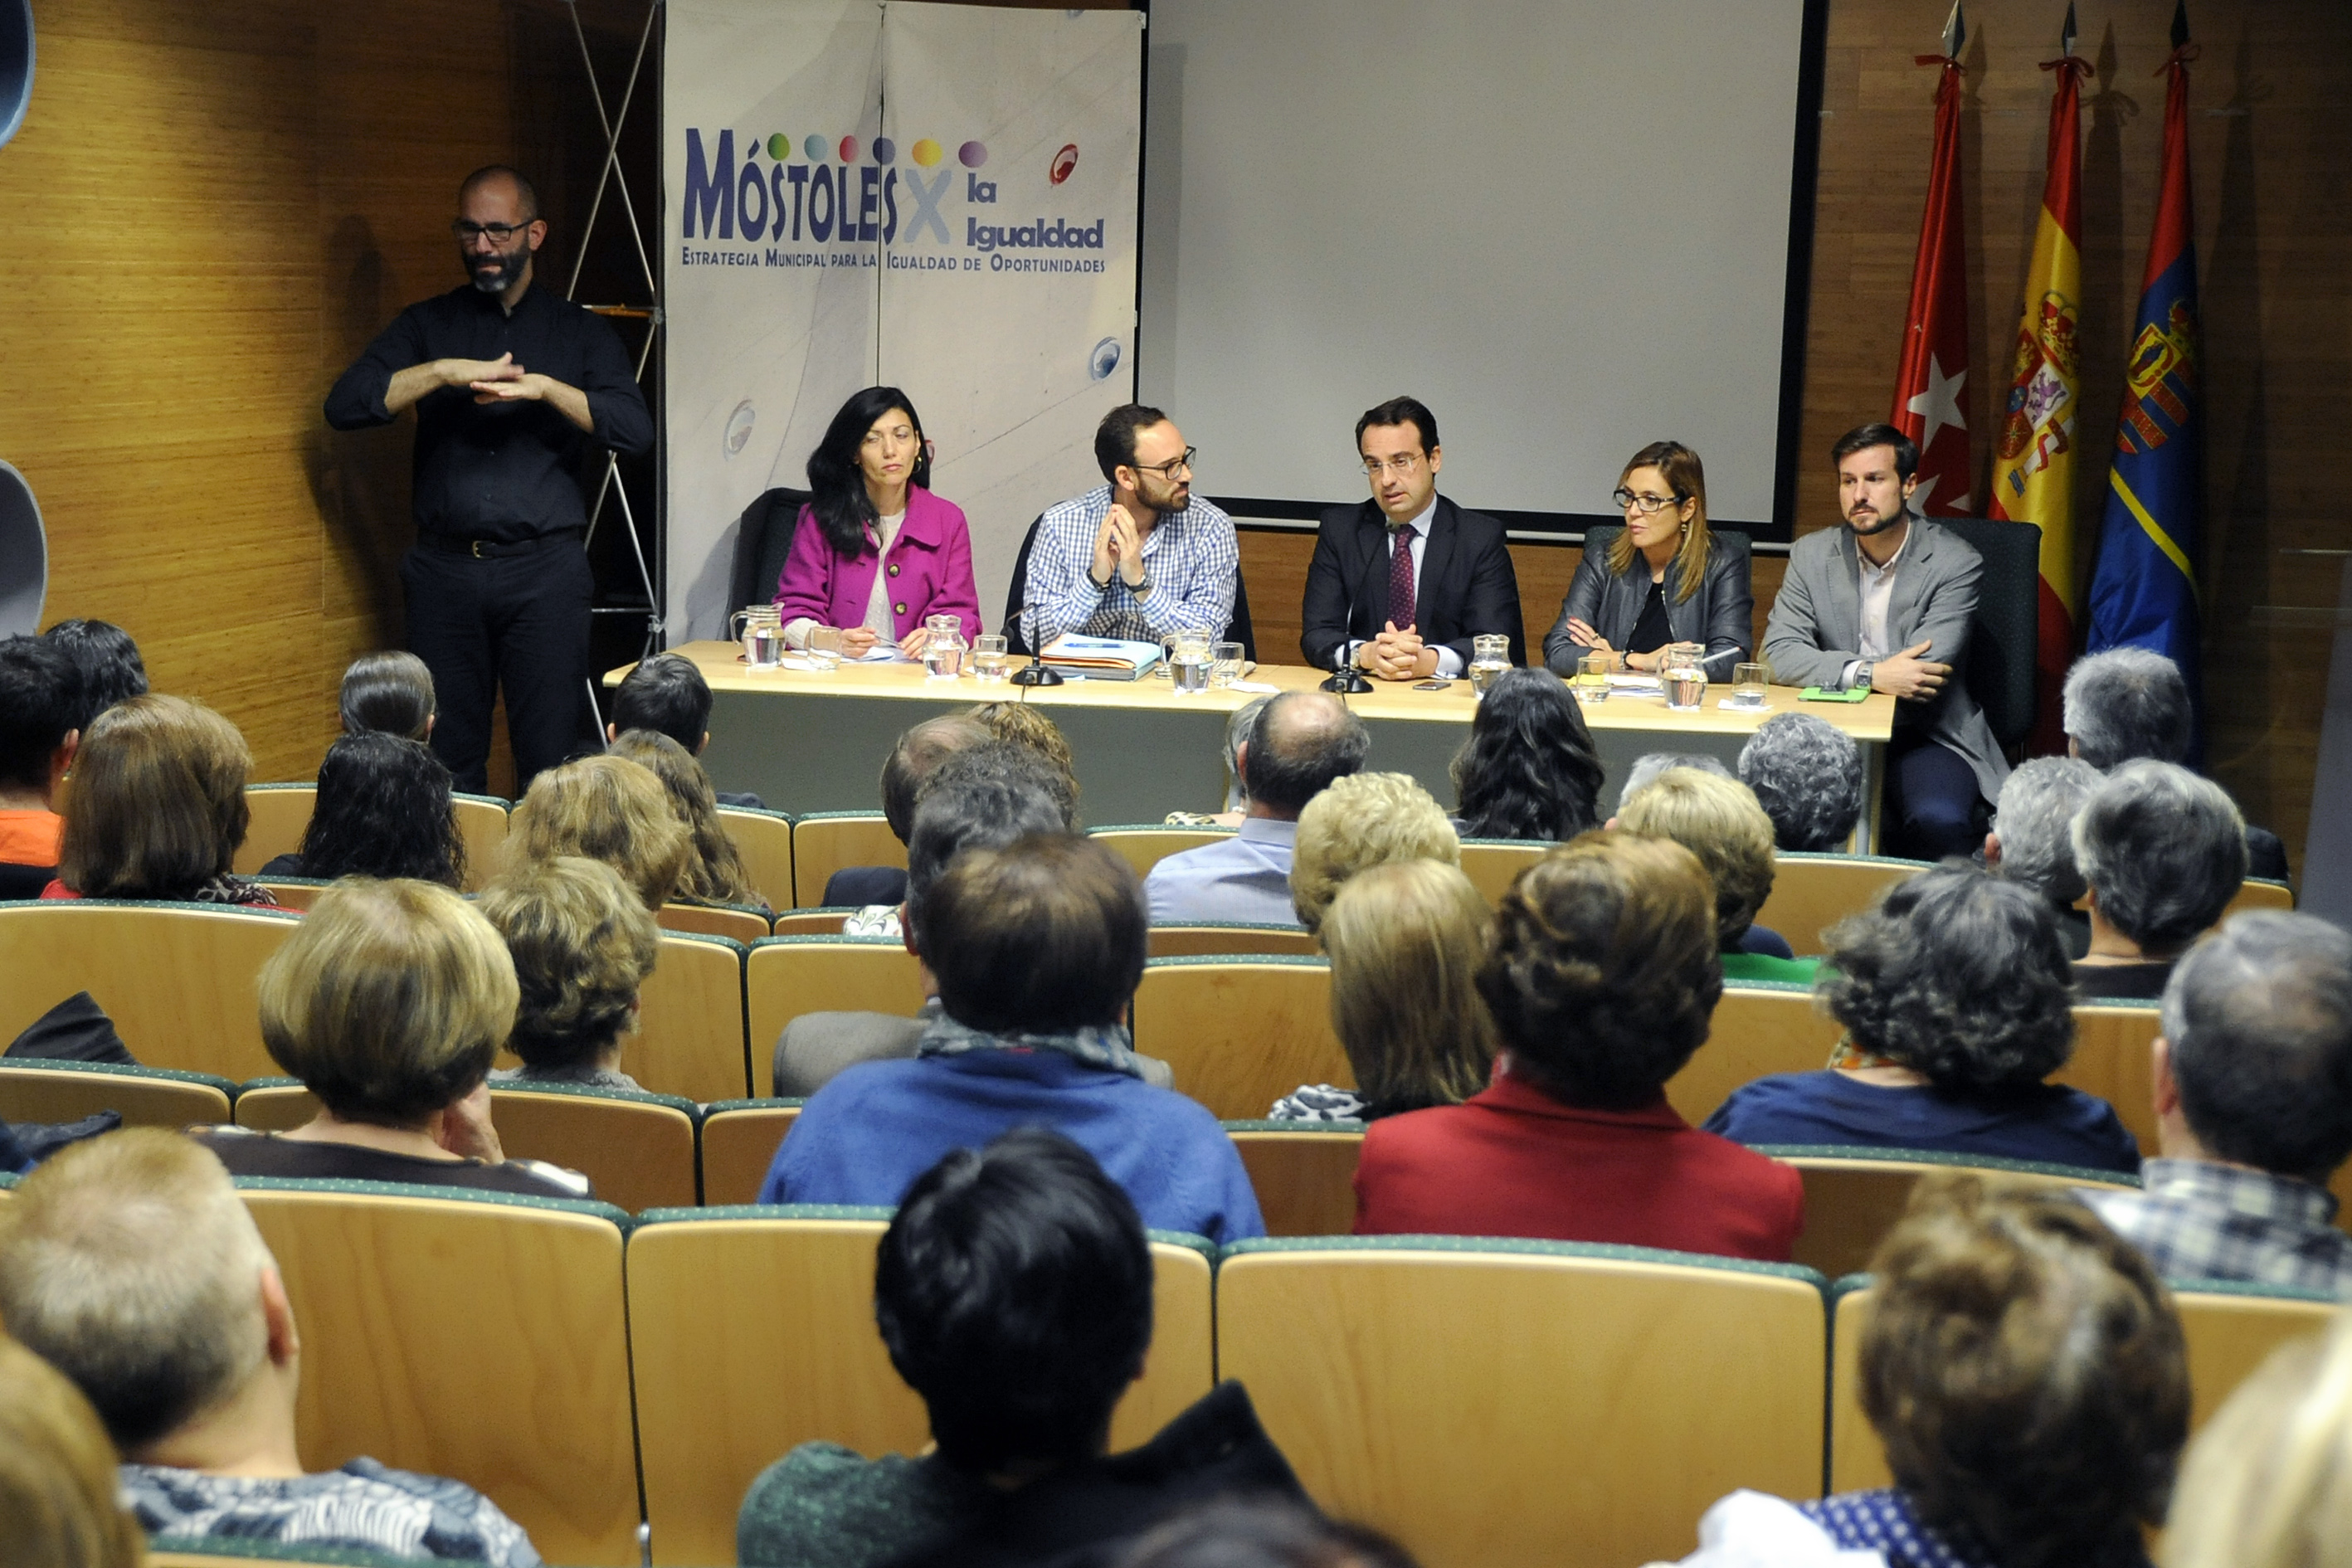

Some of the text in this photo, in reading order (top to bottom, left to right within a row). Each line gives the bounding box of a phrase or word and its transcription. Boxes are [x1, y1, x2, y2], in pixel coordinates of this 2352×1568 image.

[683, 128, 898, 246] MÓSTOLES
[967, 173, 996, 204] la
[967, 217, 1104, 252] Igualdad
[682, 246, 1106, 274] ESTRATEGIA MUNICIPAL PARA LA IGUALDAD DE OPORTUNIDADES
